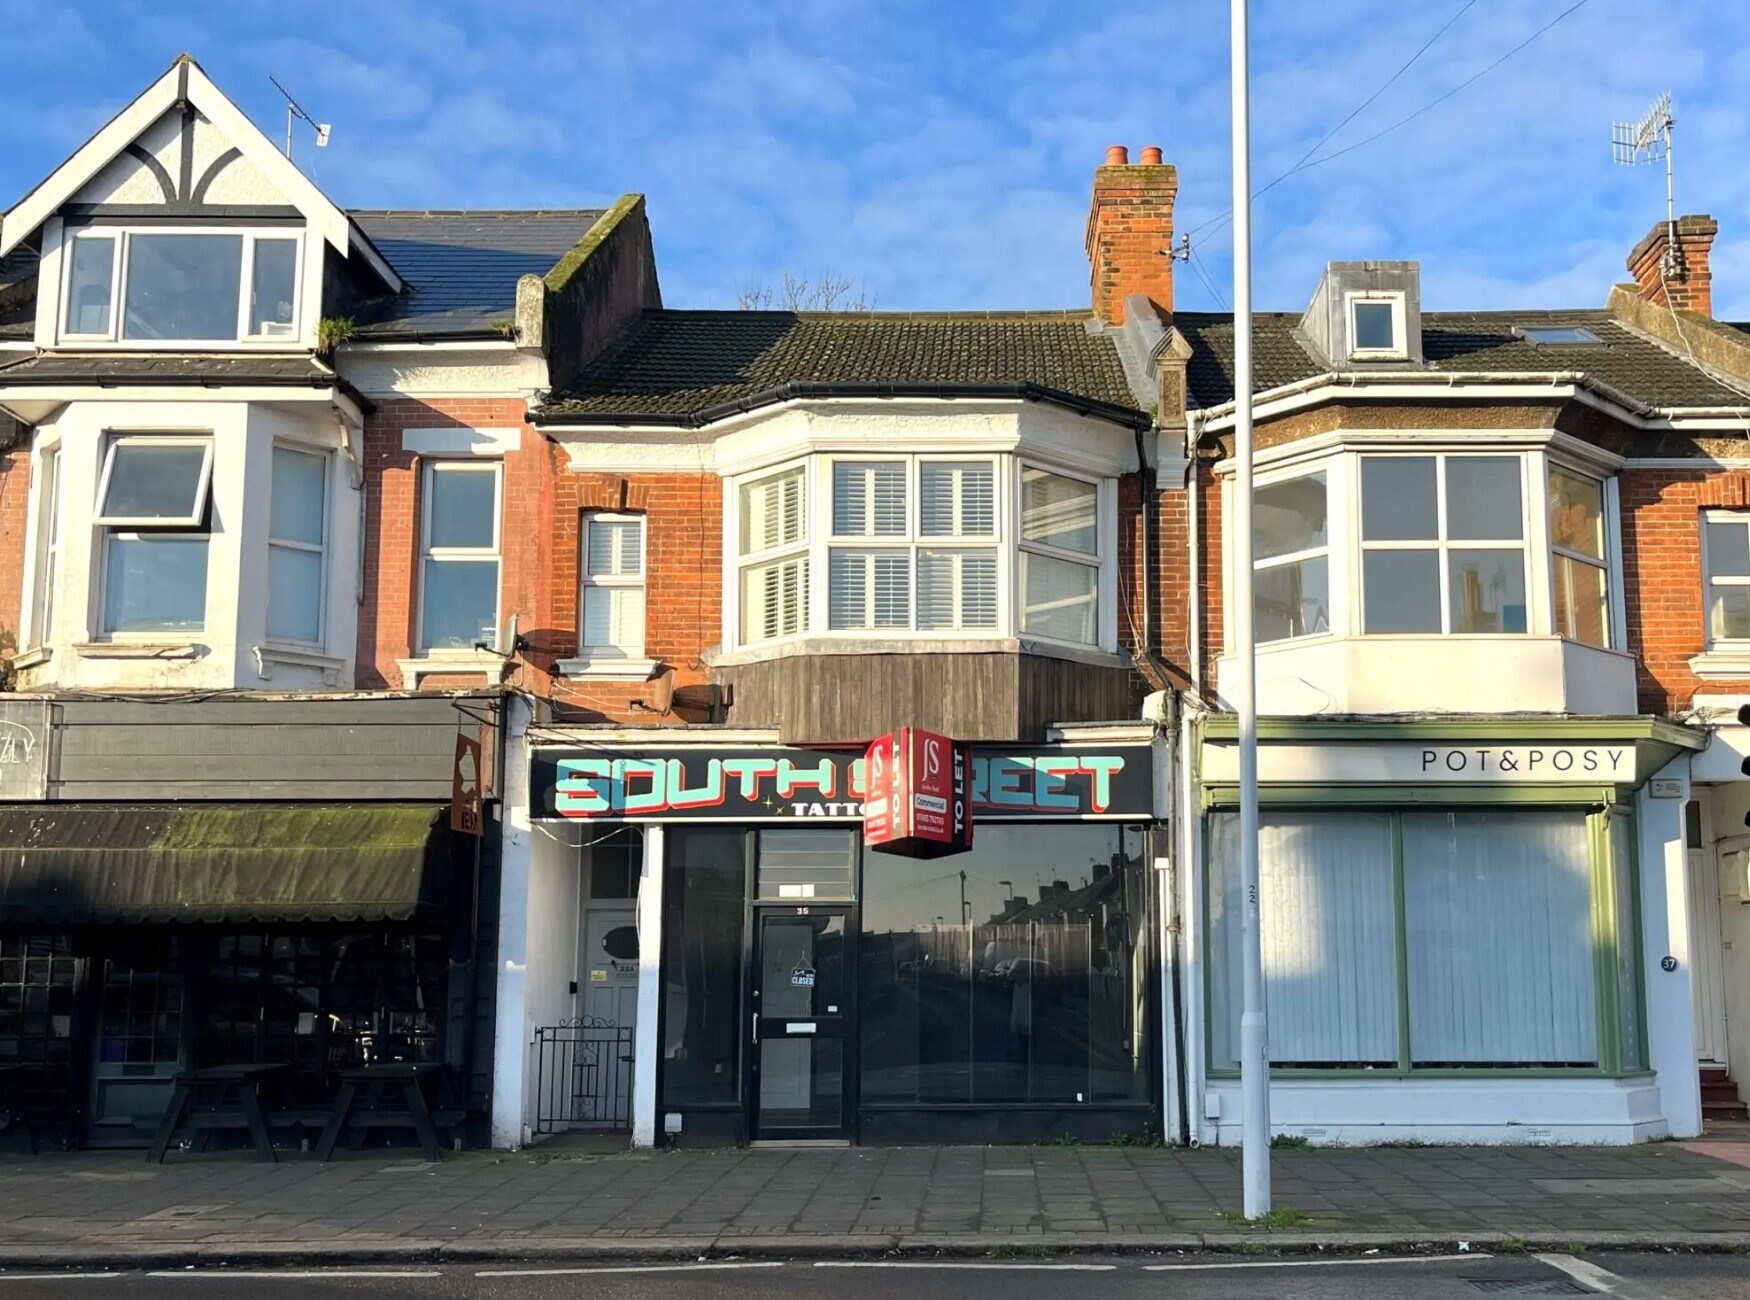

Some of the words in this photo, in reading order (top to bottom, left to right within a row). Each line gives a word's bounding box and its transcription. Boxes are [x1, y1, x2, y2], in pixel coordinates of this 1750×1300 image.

[892, 741, 900, 787] LET
[954, 749, 964, 794] LET
[1422, 750, 1623, 771] POT&POSY
[555, 759, 836, 816] SOUTH
[892, 793, 900, 829] TO
[954, 800, 964, 834] TO
[797, 907, 809, 915] 35
[791, 976, 814, 985] CLOSED
[1663, 959, 1675, 969] 37
